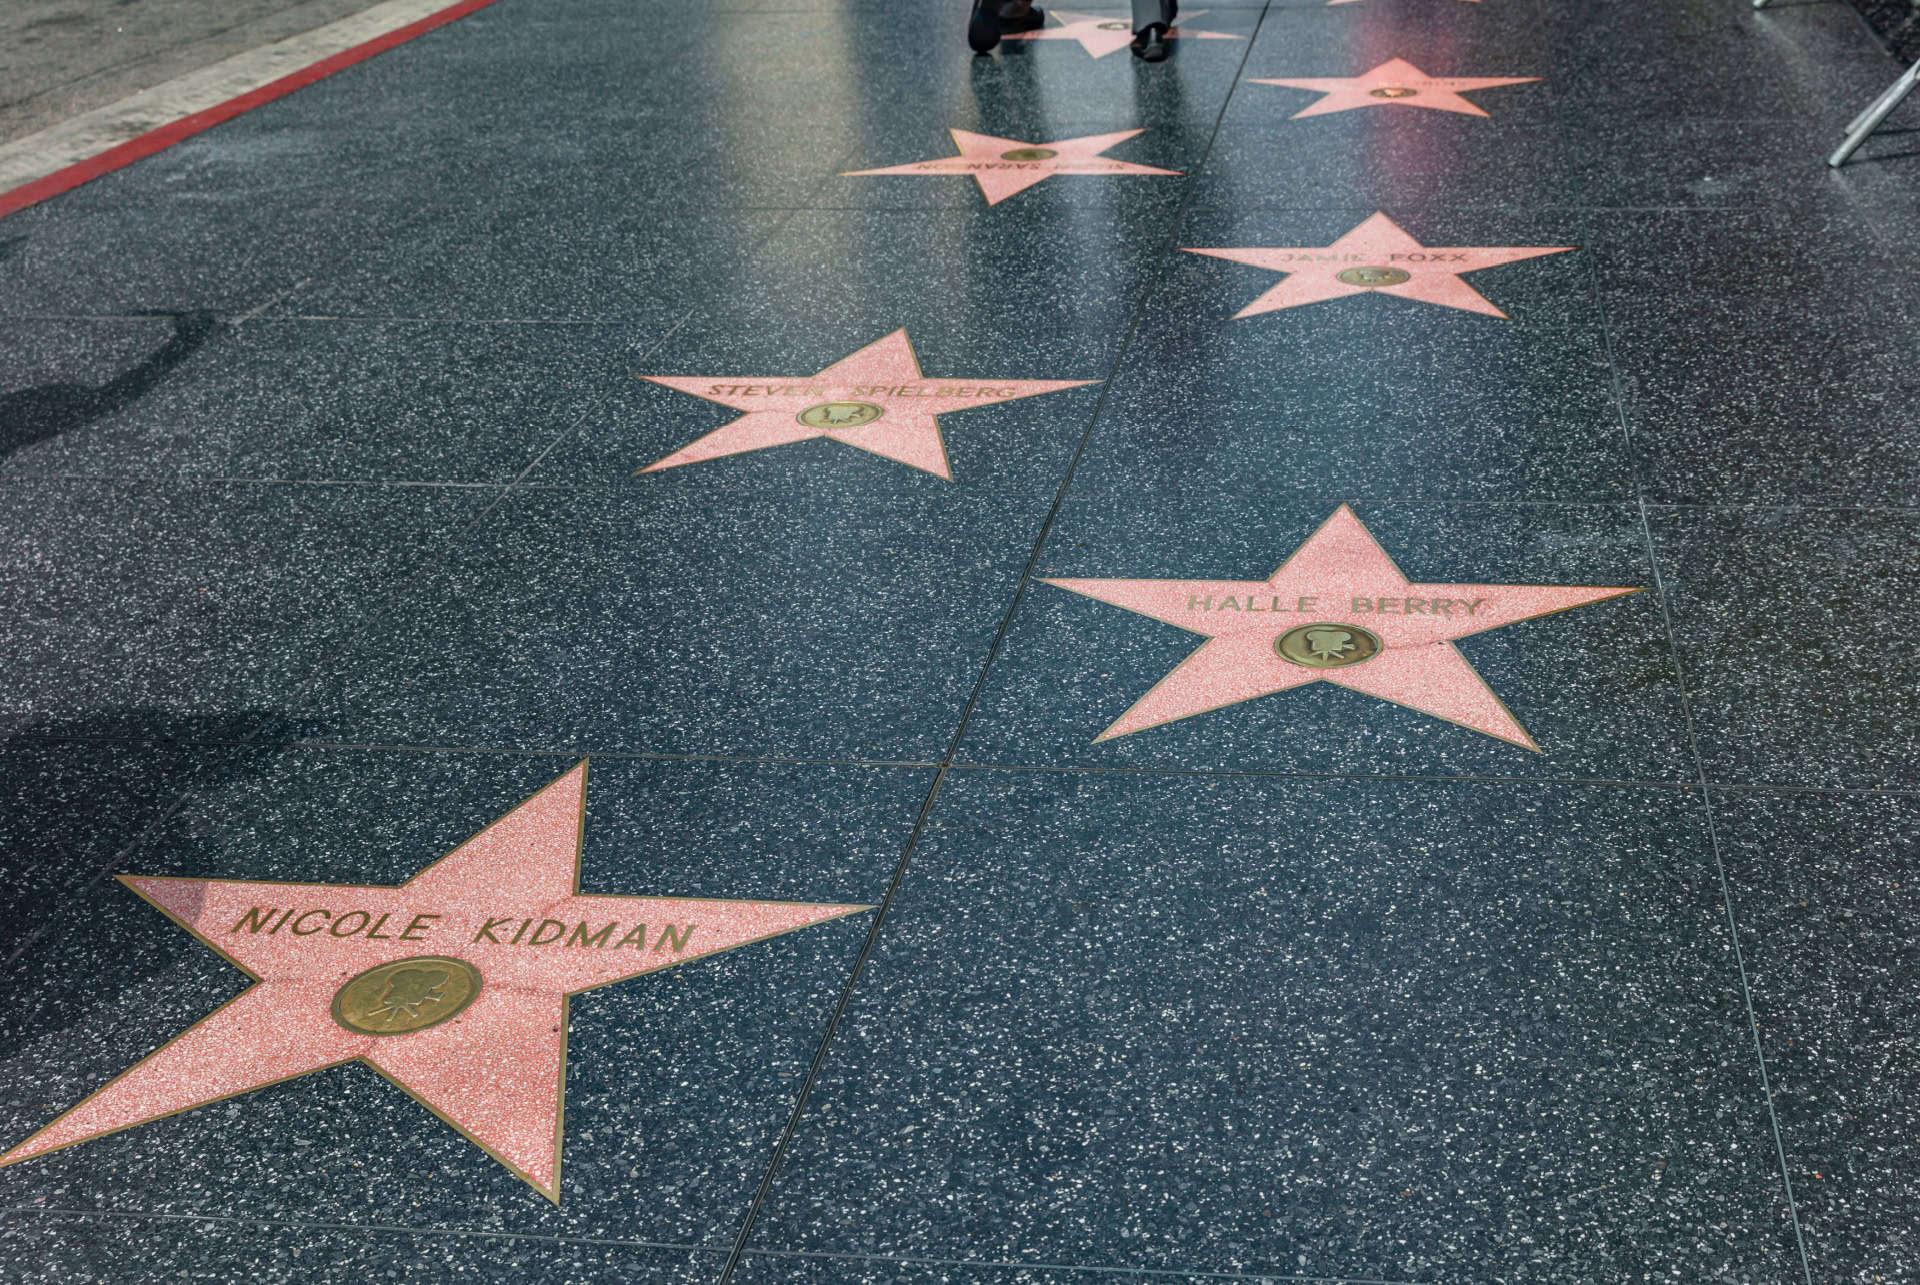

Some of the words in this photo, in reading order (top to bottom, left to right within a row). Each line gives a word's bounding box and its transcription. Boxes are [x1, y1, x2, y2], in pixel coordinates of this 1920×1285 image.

[1389, 253, 1469, 263] FOXX
[708, 384, 827, 397] STEVEN
[852, 384, 1017, 398] SPIELBERG
[1185, 595, 1320, 614] HALLE
[1350, 596, 1488, 616] BERRY
[231, 907, 442, 941] NICOLE
[473, 917, 696, 953] KIDMAN
